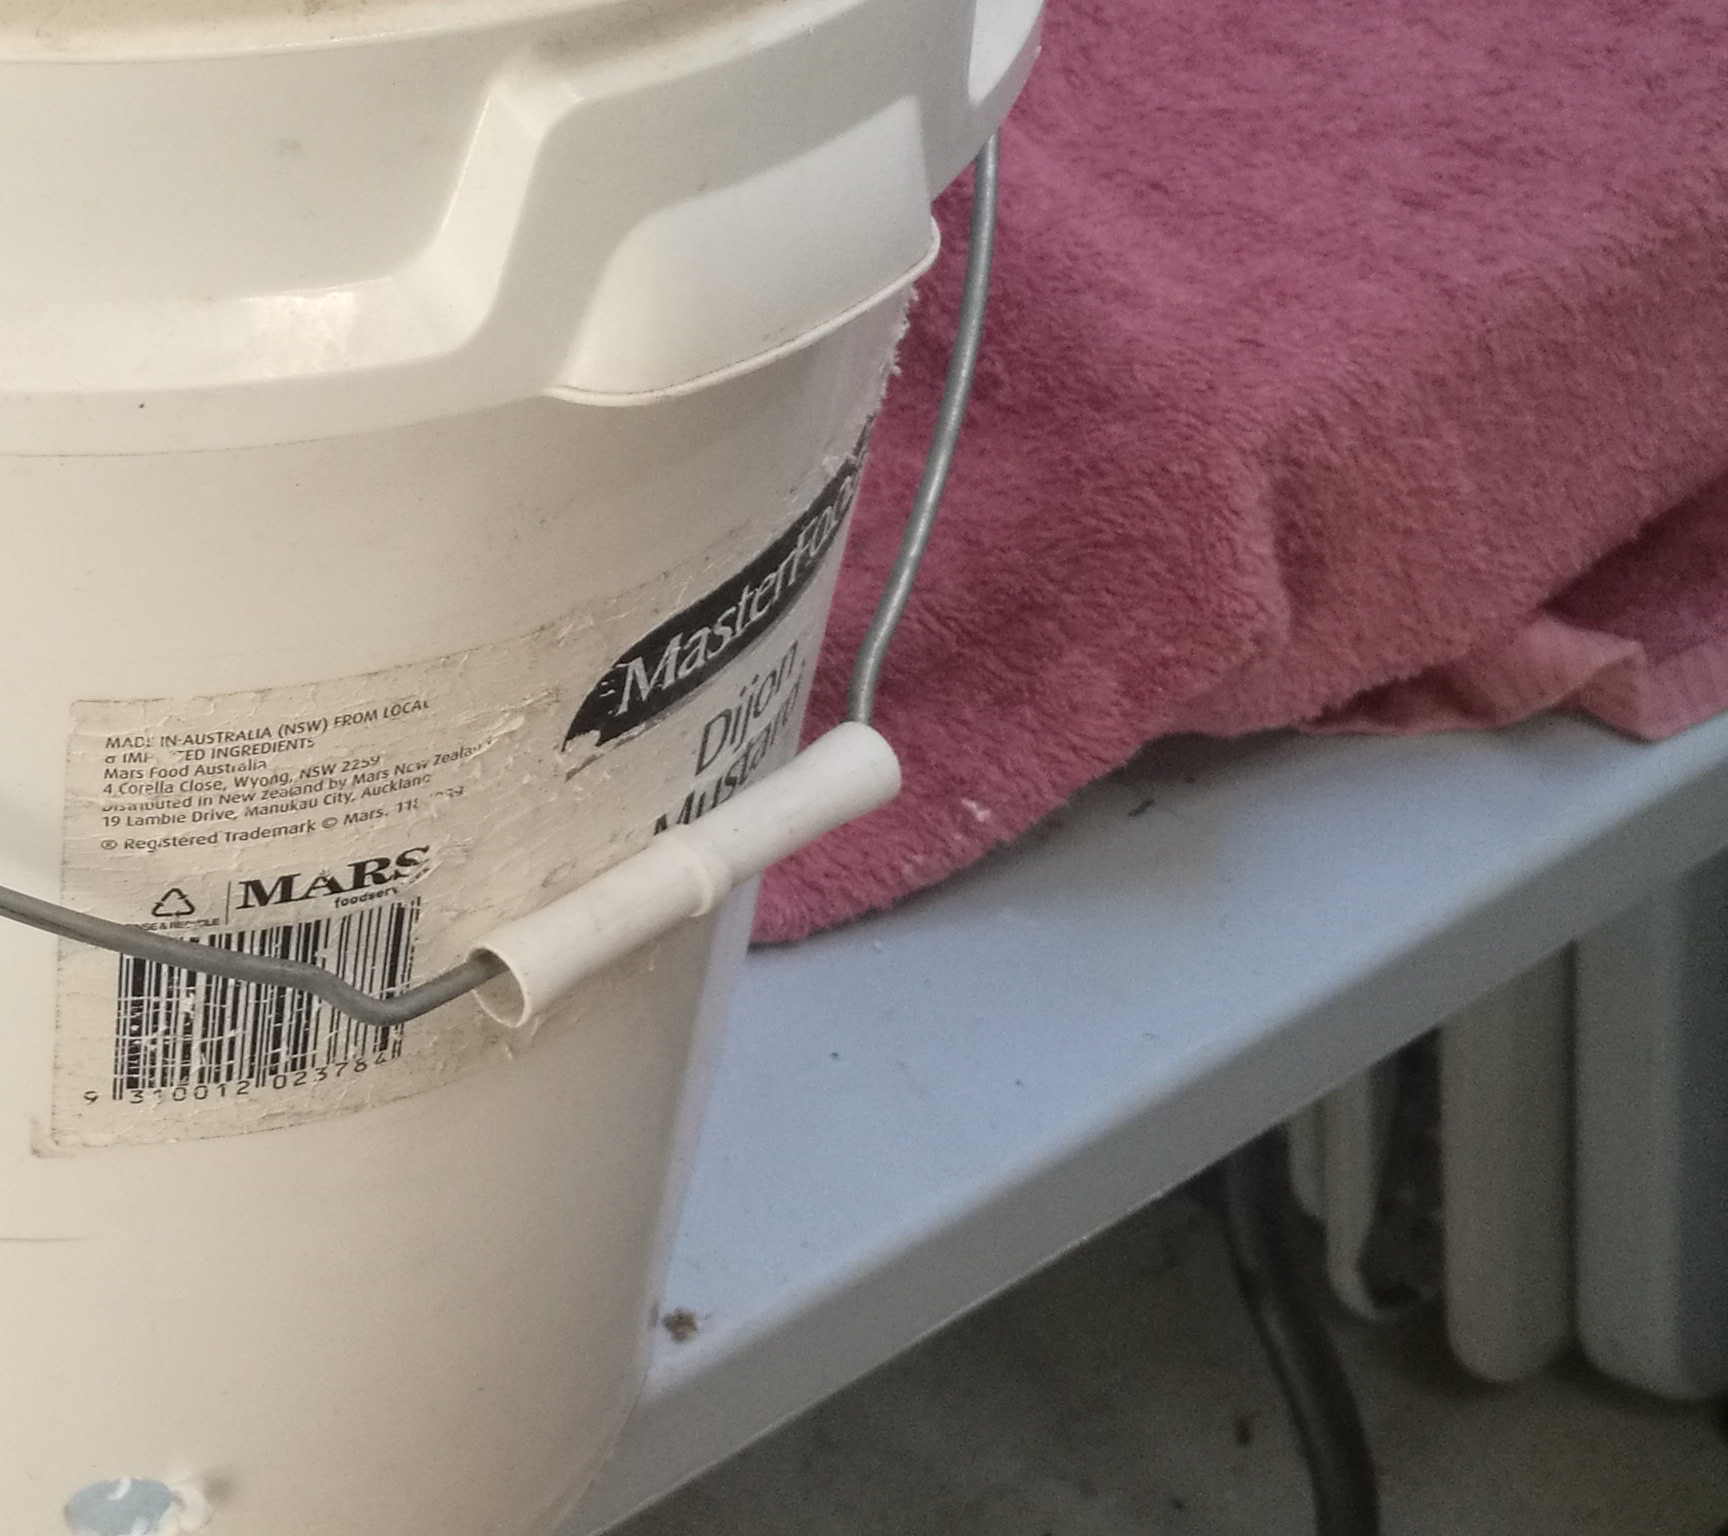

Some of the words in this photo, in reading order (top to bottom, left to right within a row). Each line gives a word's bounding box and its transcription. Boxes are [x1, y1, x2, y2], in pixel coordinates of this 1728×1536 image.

[278, 716, 329, 739] (NSW)
[334, 709, 379, 726] FROM
[383, 700, 430, 719] LOCAL
[695, 640, 798, 777] Dijon
[104, 767, 144, 779] Mars
[149, 764, 189, 779] Food
[194, 760, 267, 777] Australia
[210, 738, 315, 761] INGREDIENTS
[103, 783, 113, 795] 4
[119, 780, 173, 795] Corella
[180, 779, 227, 795] Close,
[234, 772, 293, 789] Wyong,
[299, 763, 337, 780] NSW
[341, 755, 381, 773] 2259
[198, 795, 213, 807] in
[219, 793, 255, 806] New
[261, 780, 324, 801] Zealand
[329, 777, 348, 791] by
[352, 767, 390, 786] Mars
[394, 759, 429, 777] New
[102, 815, 120, 827] 19
[127, 813, 187, 827] Lambie
[191, 810, 238, 824] Drive,
[244, 798, 318, 818] Manukau
[323, 790, 355, 807] City,
[124, 832, 219, 853] Registered
[224, 818, 316, 843] Trademark
[343, 806, 389, 825] Mars.
[235, 845, 430, 910] MARS
